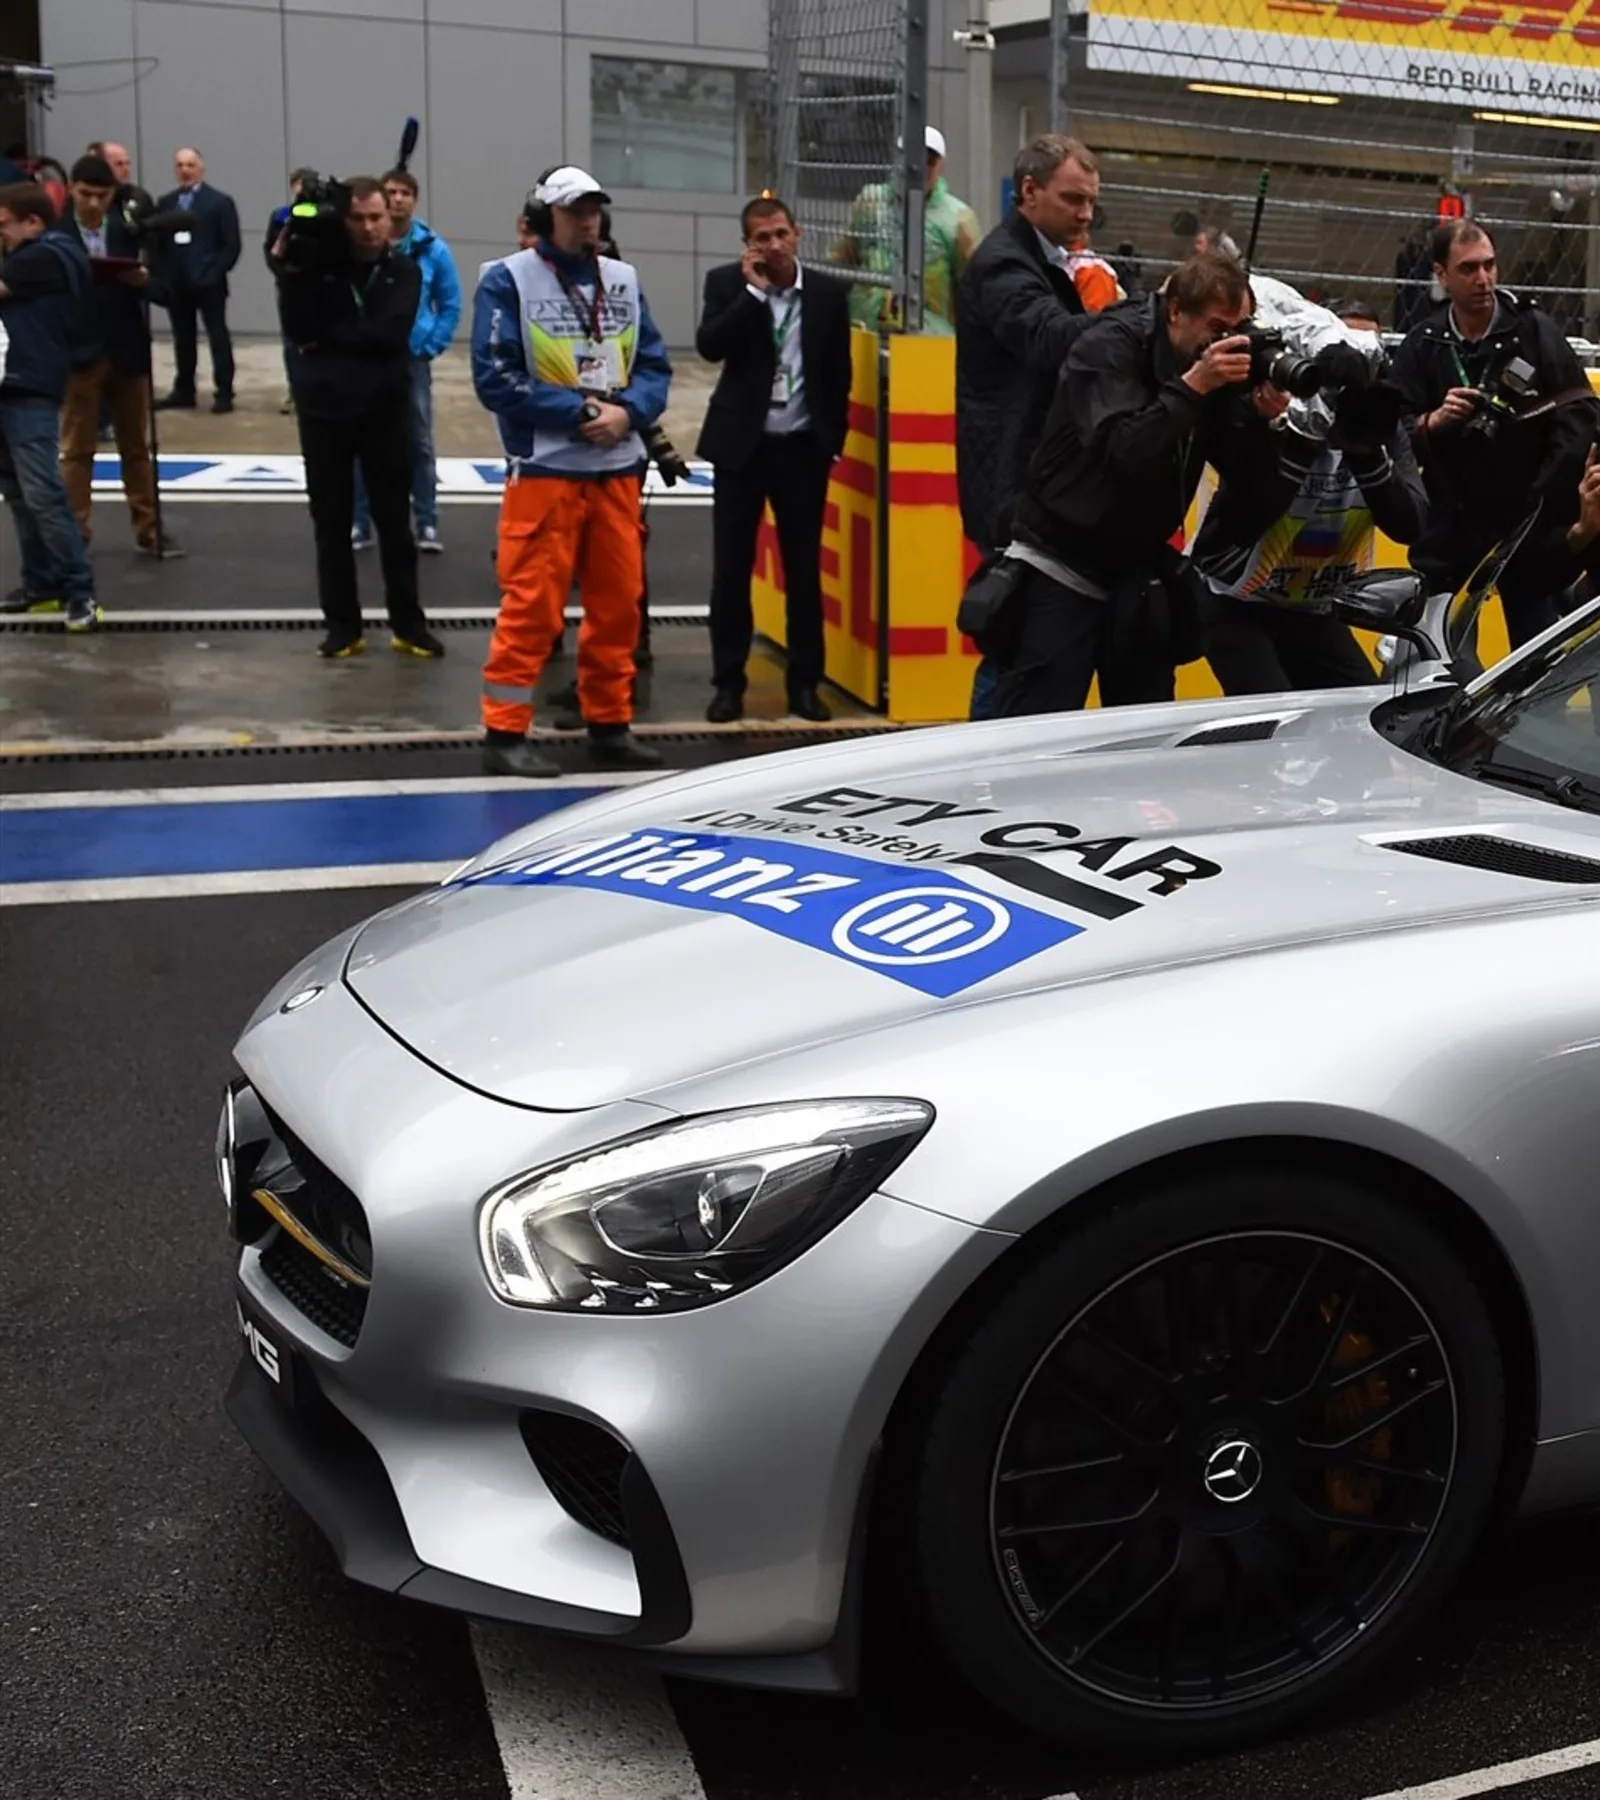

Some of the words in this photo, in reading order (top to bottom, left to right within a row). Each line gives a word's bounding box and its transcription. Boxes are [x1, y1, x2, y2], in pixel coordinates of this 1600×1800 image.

[1406, 64, 1454, 89] RED
[1462, 68, 1519, 97] BULL
[715, 811, 817, 835] Drive
[816, 825, 969, 863] Safely
[773, 786, 1000, 827] ETY
[979, 821, 1224, 897] CAR
